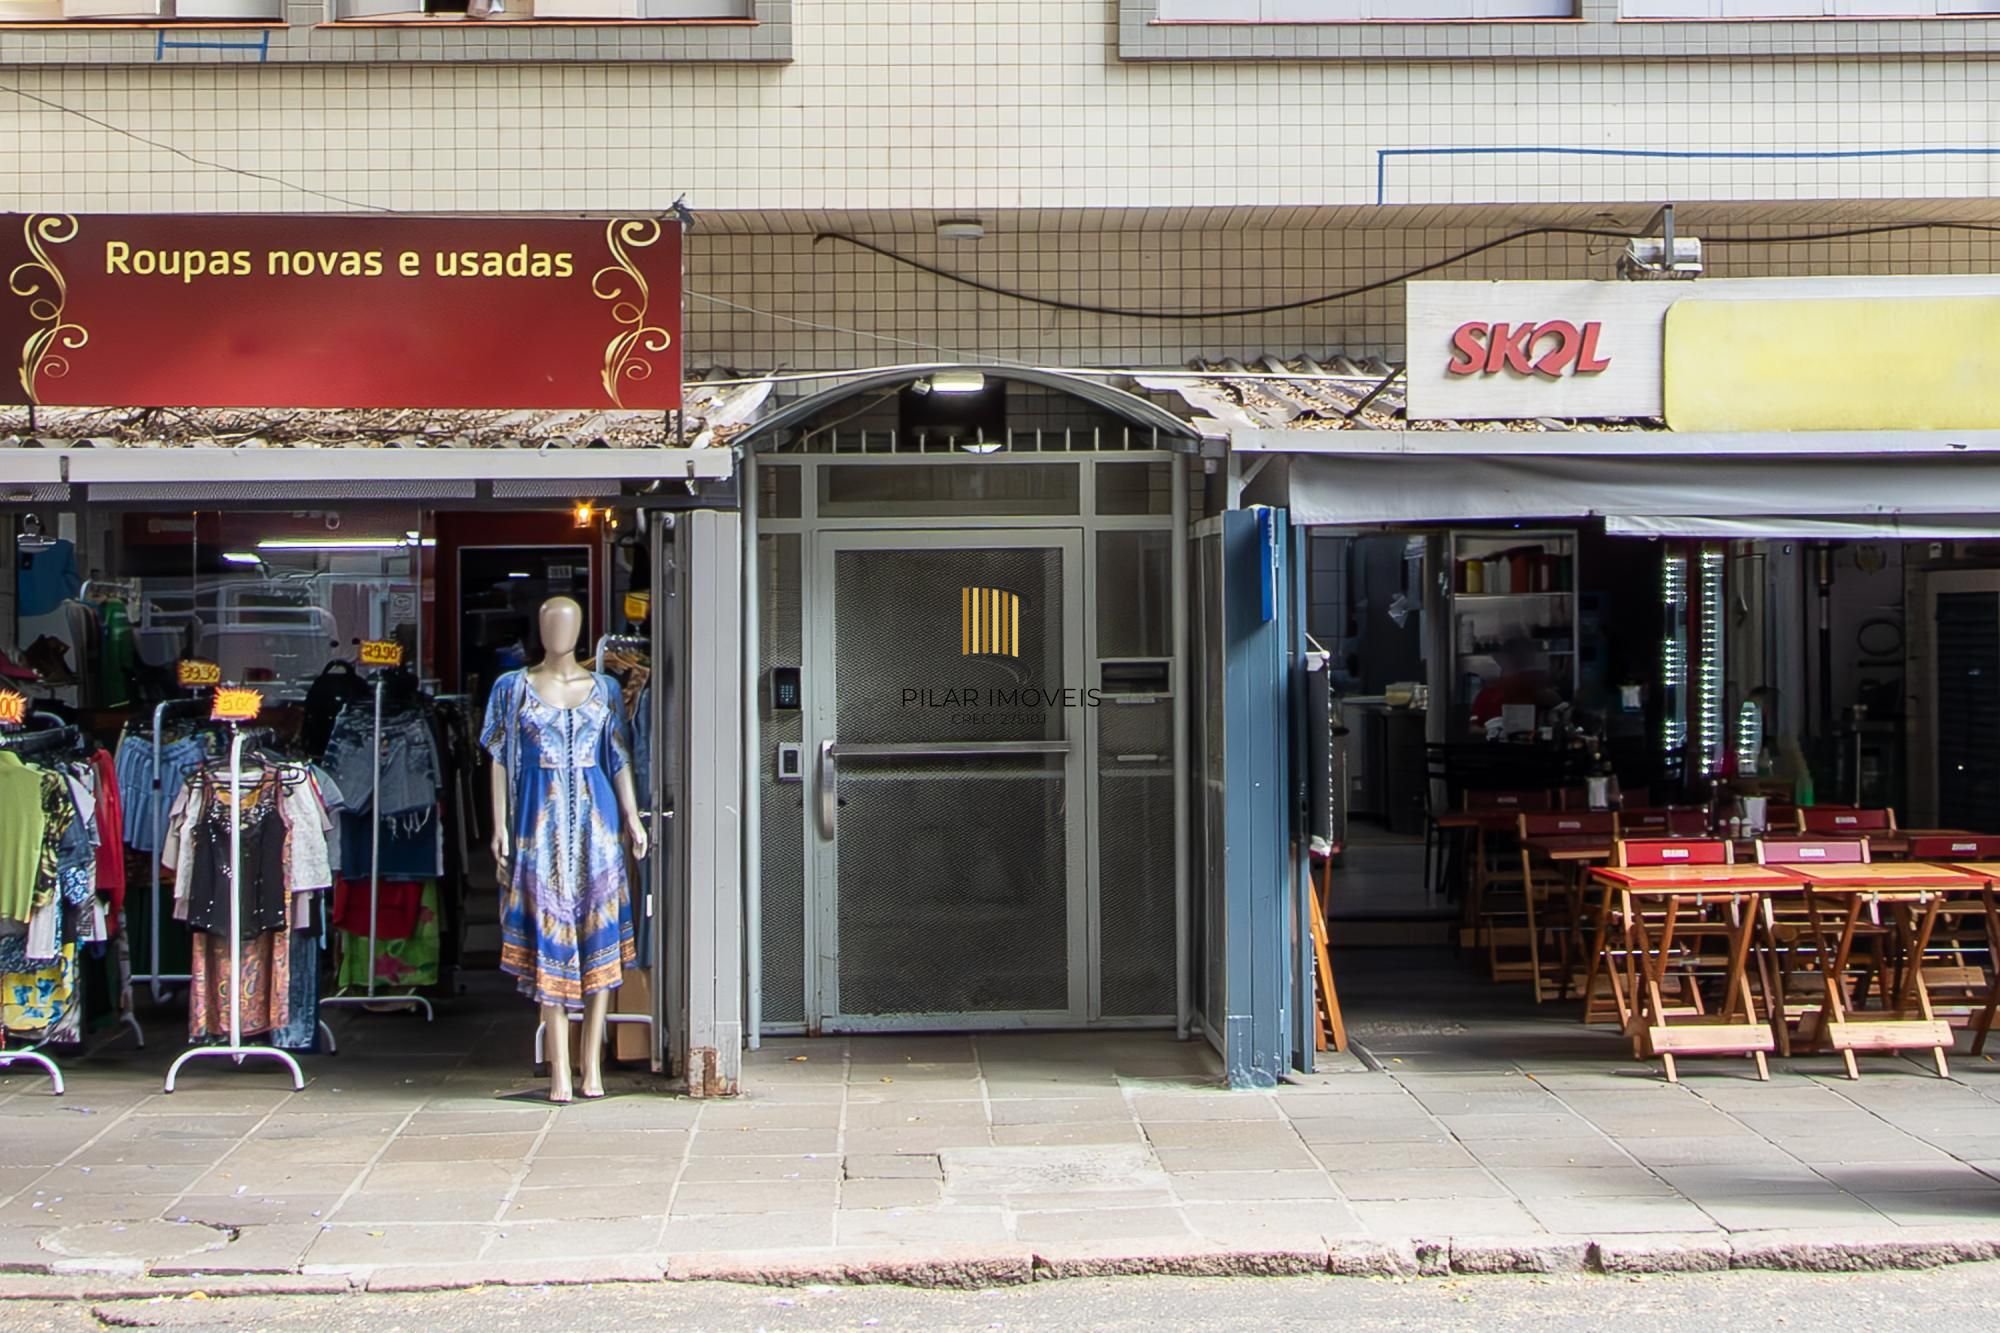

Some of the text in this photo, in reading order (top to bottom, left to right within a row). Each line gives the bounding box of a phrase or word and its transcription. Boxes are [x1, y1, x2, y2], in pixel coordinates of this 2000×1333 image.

[106, 240, 574, 284] Roupas novas e usadas
[1448, 319, 1612, 377] SKOL
